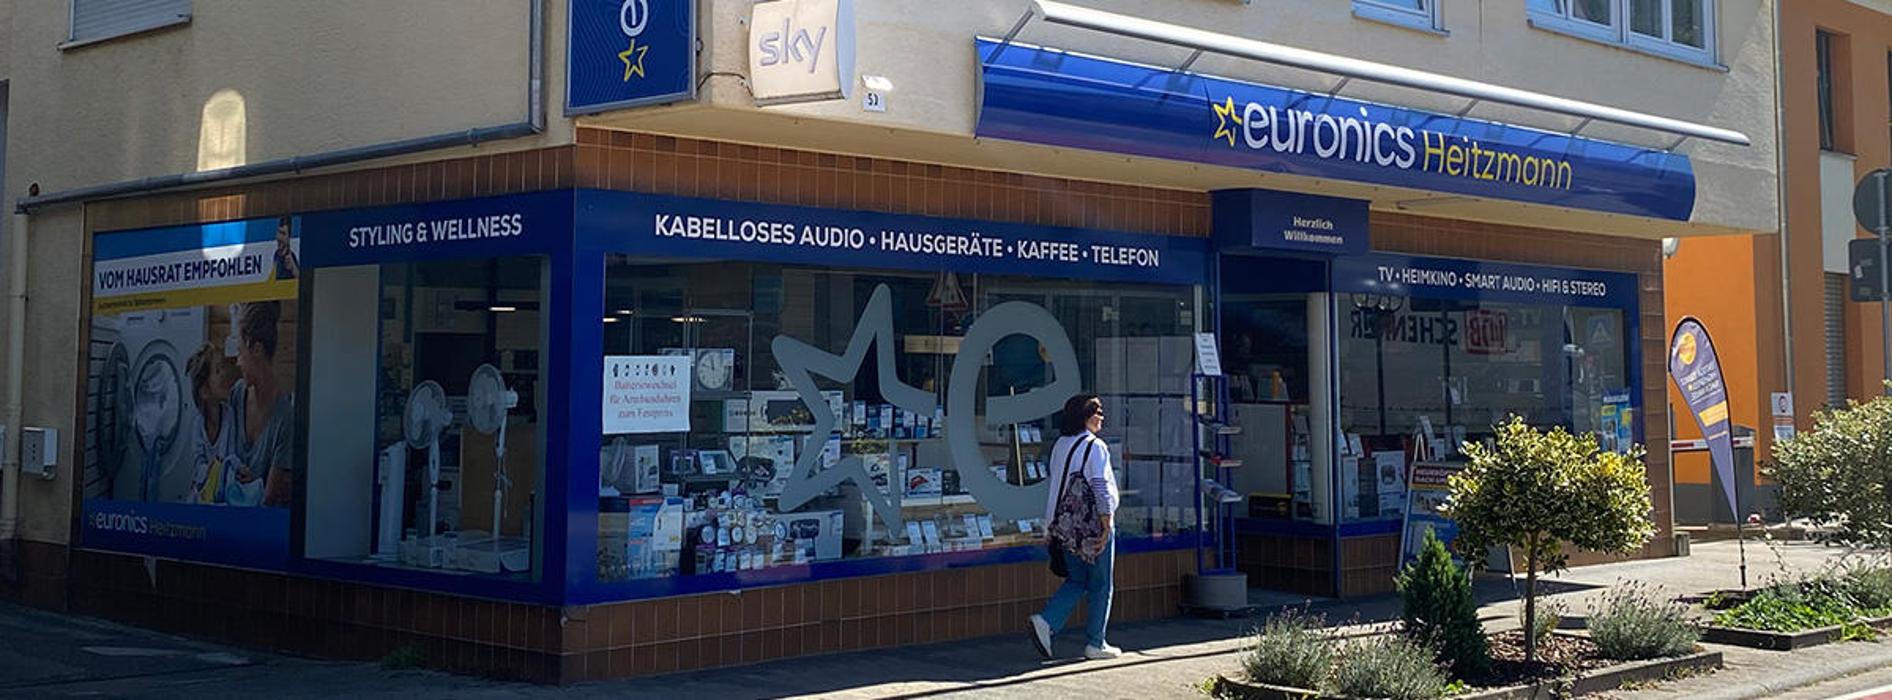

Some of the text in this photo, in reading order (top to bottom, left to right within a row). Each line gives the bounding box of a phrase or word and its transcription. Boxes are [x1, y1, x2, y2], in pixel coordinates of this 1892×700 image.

[759, 17, 827, 73] sky
[1243, 102, 1572, 190] euronics Heitzmann
[349, 214, 522, 248] STYLING & WELLNESS
[1283, 230, 1344, 244] Willkommen
[1293, 216, 1333, 230] Herzlich
[655, 214, 1159, 267] KABELLOSES AUDIO HAUSGERÄTE KAFFEE TELEFON
[99, 254, 262, 289] VOM HAUSRAT EMPFOHLEN
[1378, 266, 1606, 296] TV HEIMKINO SMART AUDIO HIFI & STEREO
[95, 510, 148, 534] euronics
